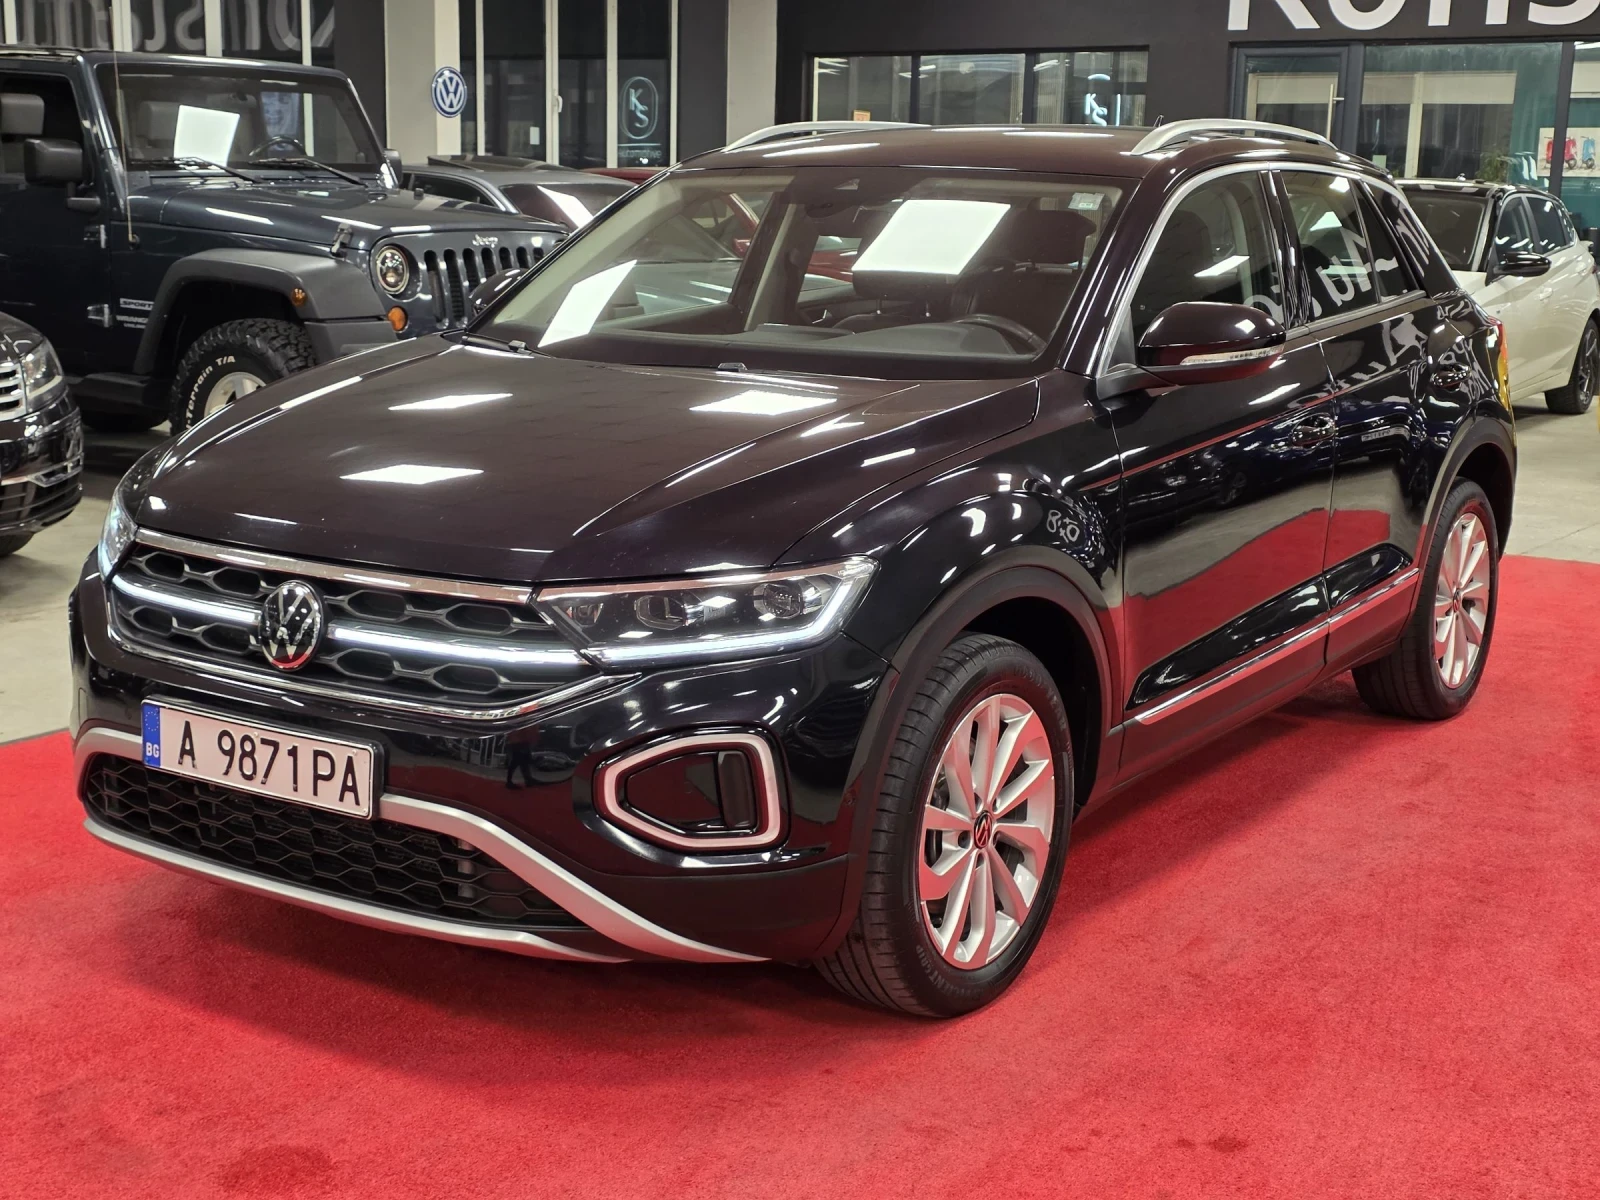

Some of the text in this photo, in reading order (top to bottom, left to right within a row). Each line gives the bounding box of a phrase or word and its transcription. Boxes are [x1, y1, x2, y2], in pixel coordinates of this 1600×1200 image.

[472, 233, 499, 248] Jeep
[121, 300, 153, 309] SPORT
[215, 355, 236, 366] T/A
[145, 741, 160, 759] BG
[177, 719, 198, 770] A
